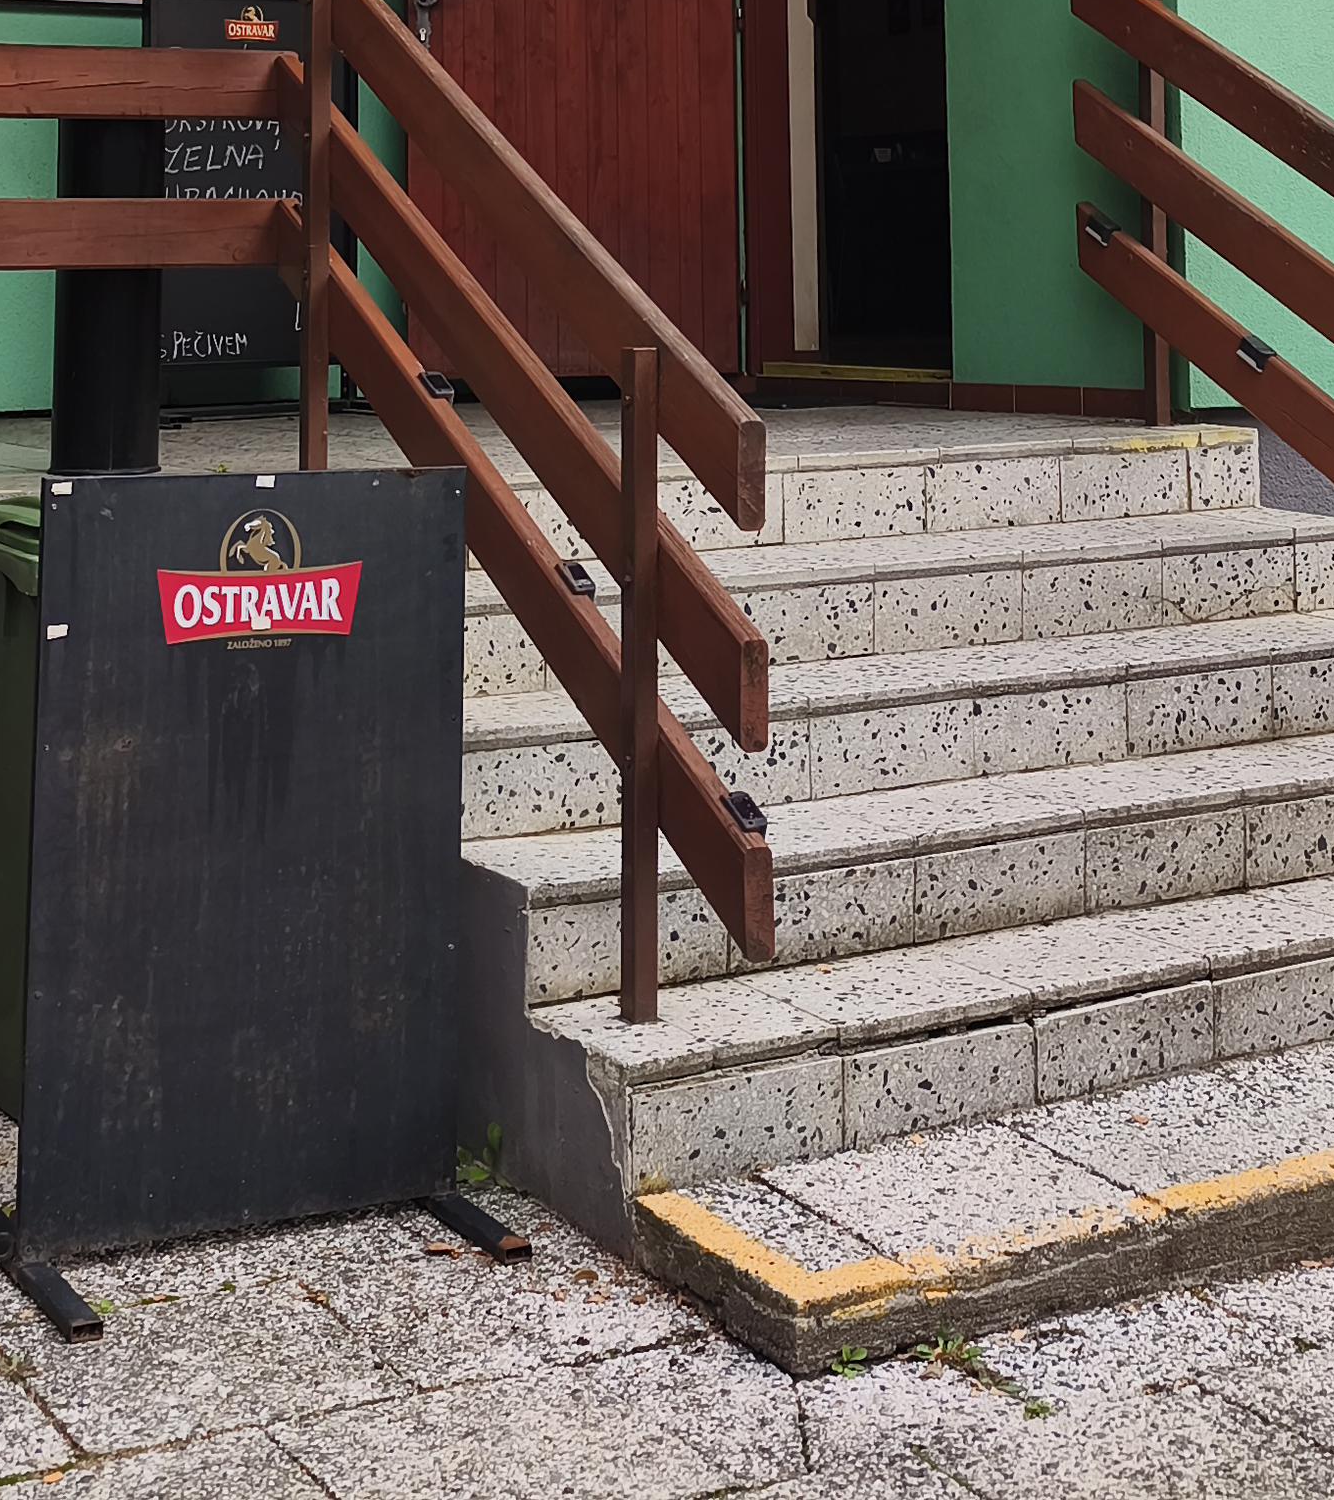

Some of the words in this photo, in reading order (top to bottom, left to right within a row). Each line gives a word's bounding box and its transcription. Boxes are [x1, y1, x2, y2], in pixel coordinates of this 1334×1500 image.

[228, 23, 276, 38] OSTRAVAR
[173, 331, 248, 359] PEČIVEM
[173, 578, 343, 629] OSTRAVAR
